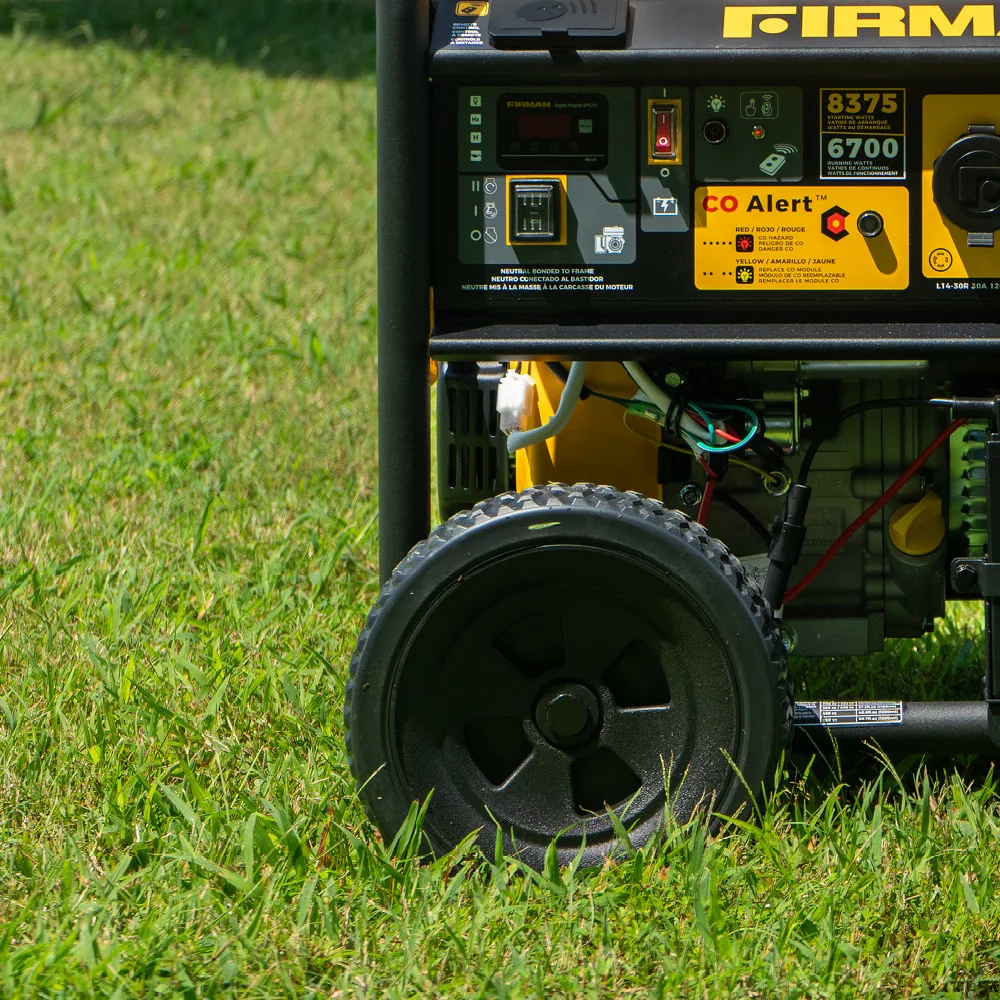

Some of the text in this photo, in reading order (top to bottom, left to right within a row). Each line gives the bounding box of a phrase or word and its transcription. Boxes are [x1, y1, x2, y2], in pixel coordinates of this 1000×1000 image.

[827, 93, 897, 113] 8375
[827, 138, 899, 158] 6700
[702, 195, 738, 212] CO
[746, 194, 813, 213] Alert
[936, 282, 969, 290] L14-30R
[971, 282, 987, 290] 30A
